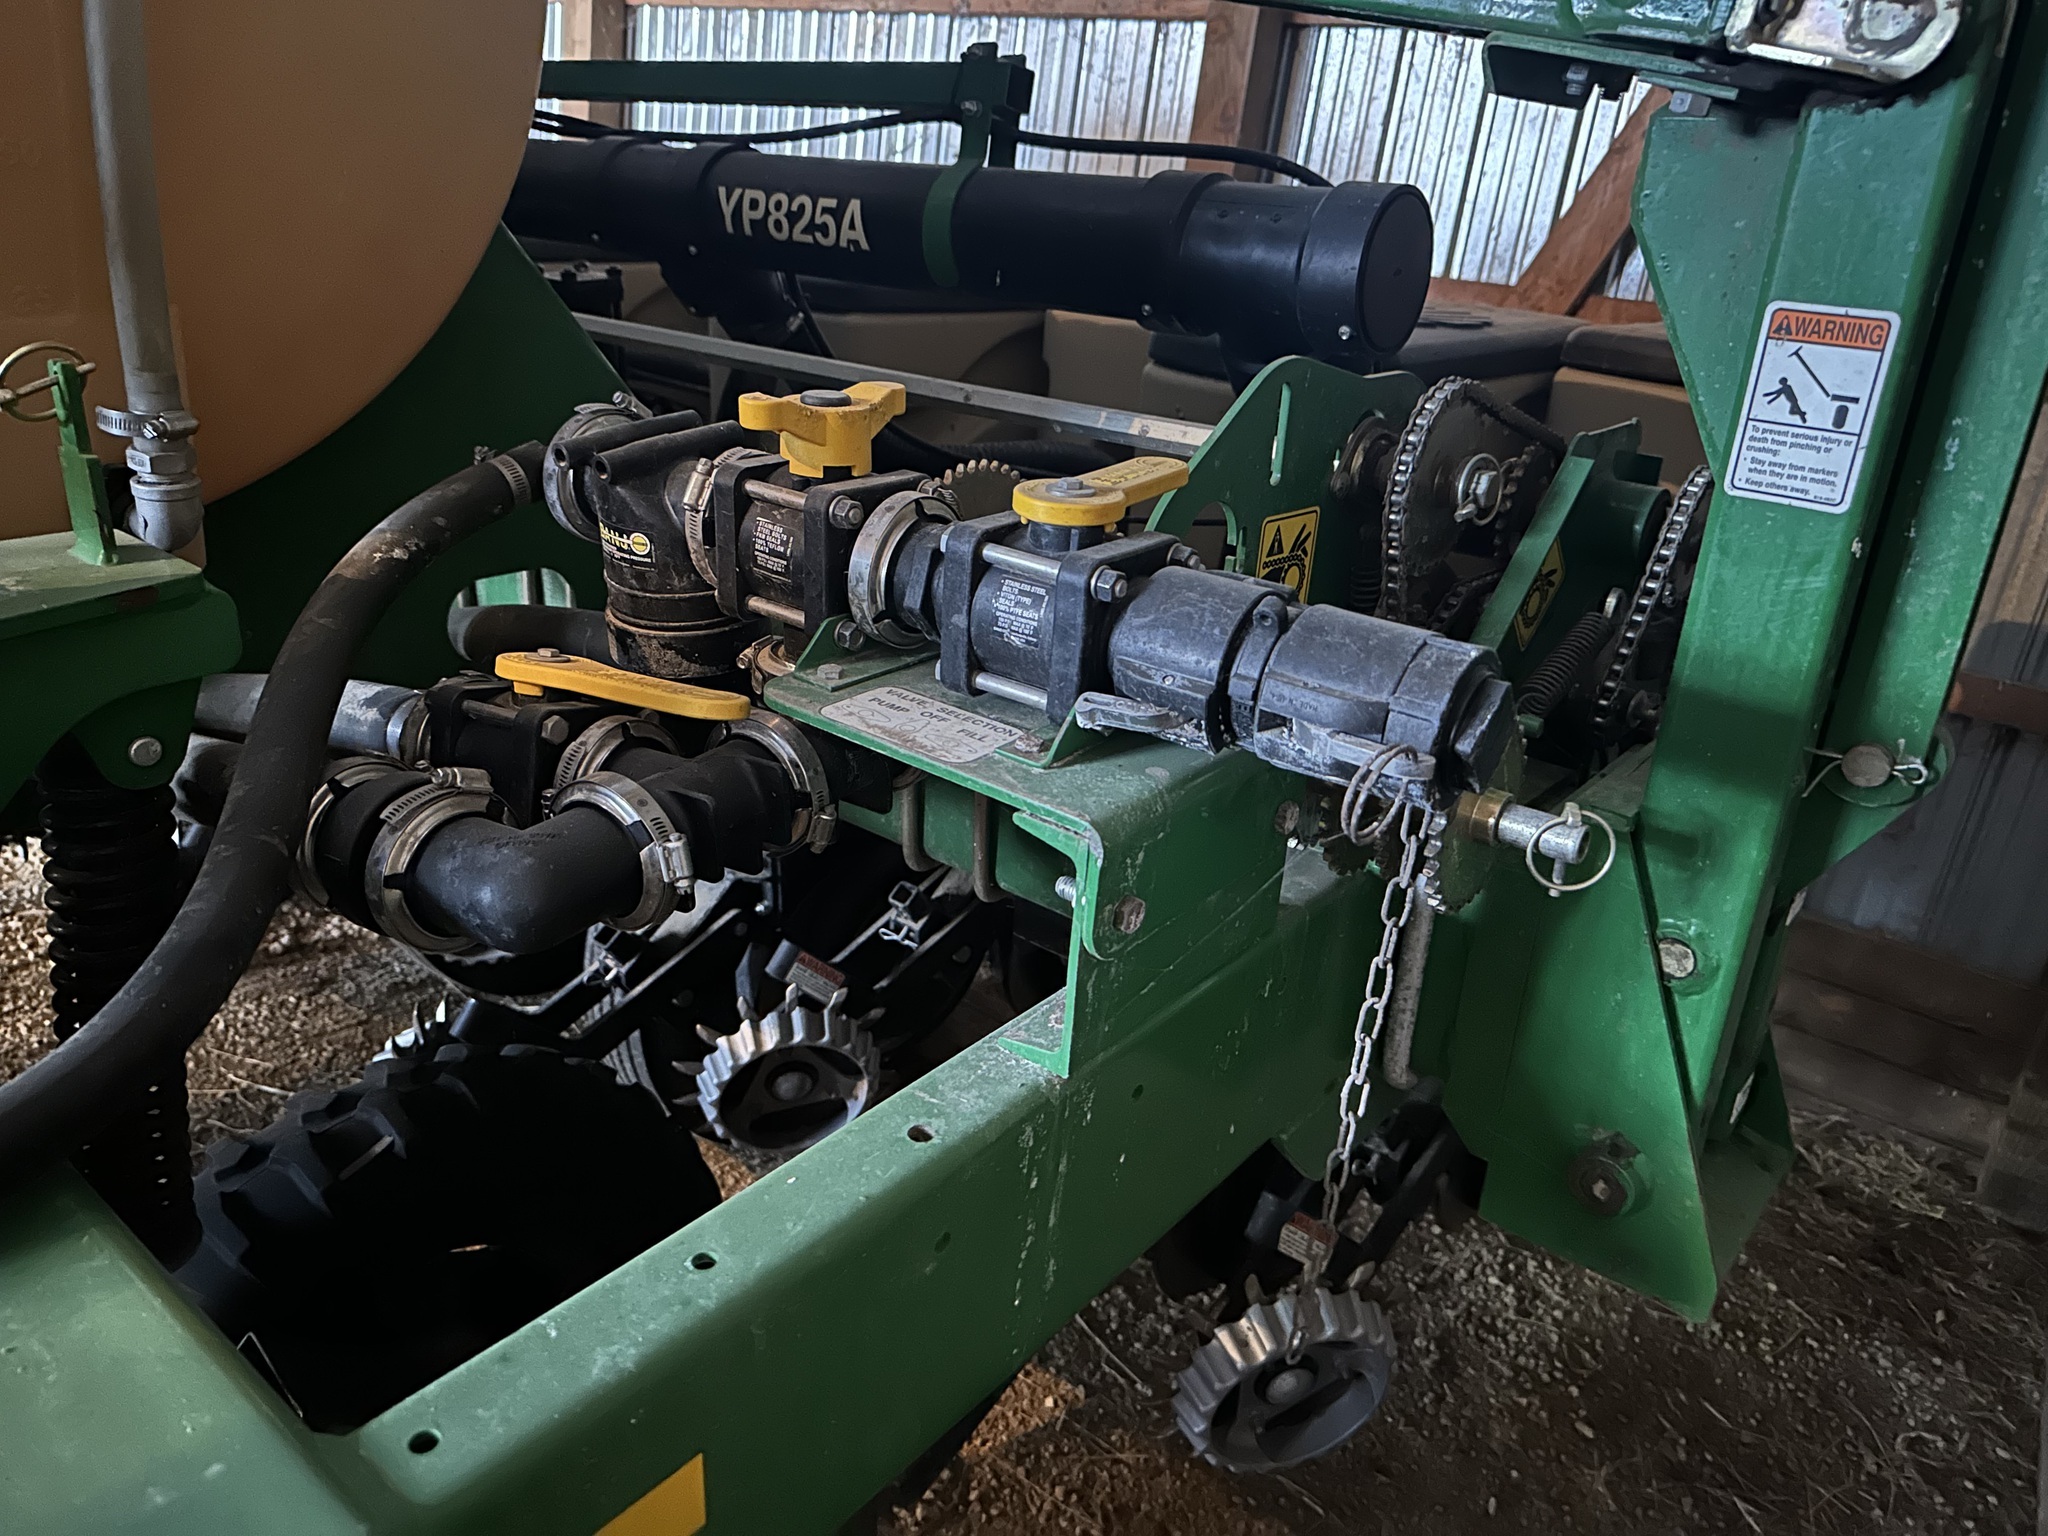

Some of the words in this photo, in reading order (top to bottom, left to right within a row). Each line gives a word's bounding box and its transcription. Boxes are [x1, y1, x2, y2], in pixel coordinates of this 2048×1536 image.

[718, 186, 870, 252] YP825A
[1795, 316, 1885, 346] WARNING
[1748, 434, 1769, 444] death
[1770, 437, 1788, 447] from
[1789, 440, 1821, 453] pinching
[1823, 446, 1833, 454] or
[1751, 424, 1760, 433] To
[1761, 426, 1789, 438] prevent
[1791, 429, 1819, 442] serious
[1820, 434, 1842, 447] injury
[1844, 439, 1853, 447] or
[1746, 444, 1781, 457] crushing:
[1747, 466, 1768, 476] when
[1768, 469, 1785, 480] they
[1786, 473, 1798, 481] are
[1799, 474, 1808, 482] in
[1808, 476, 1838, 487] motion.
[1750, 456, 1767, 467] Stay
[1768, 460, 1787, 470] away
[1788, 462, 1806, 473] from
[1807, 465, 1839, 478] markers
[1745, 477, 1764, 488] Keep
[1764, 480, 1788, 491] others
[1789, 485, 1811, 496] away.
[758, 521, 784, 533] STAINLESS
[1002, 585, 1019, 595] BOLTS
[1004, 579, 1032, 592] STAINLESS
[1031, 586, 1047, 596] STEEL
[1010, 607, 1023, 616] PTFE
[1022, 610, 1039, 621] SEATS
[868, 697, 911, 713] PUMP
[919, 710, 951, 724] OFF
[956, 728, 986, 743] FILL
[886, 689, 929, 708] VALVE
[936, 706, 1018, 737] SELECTION
